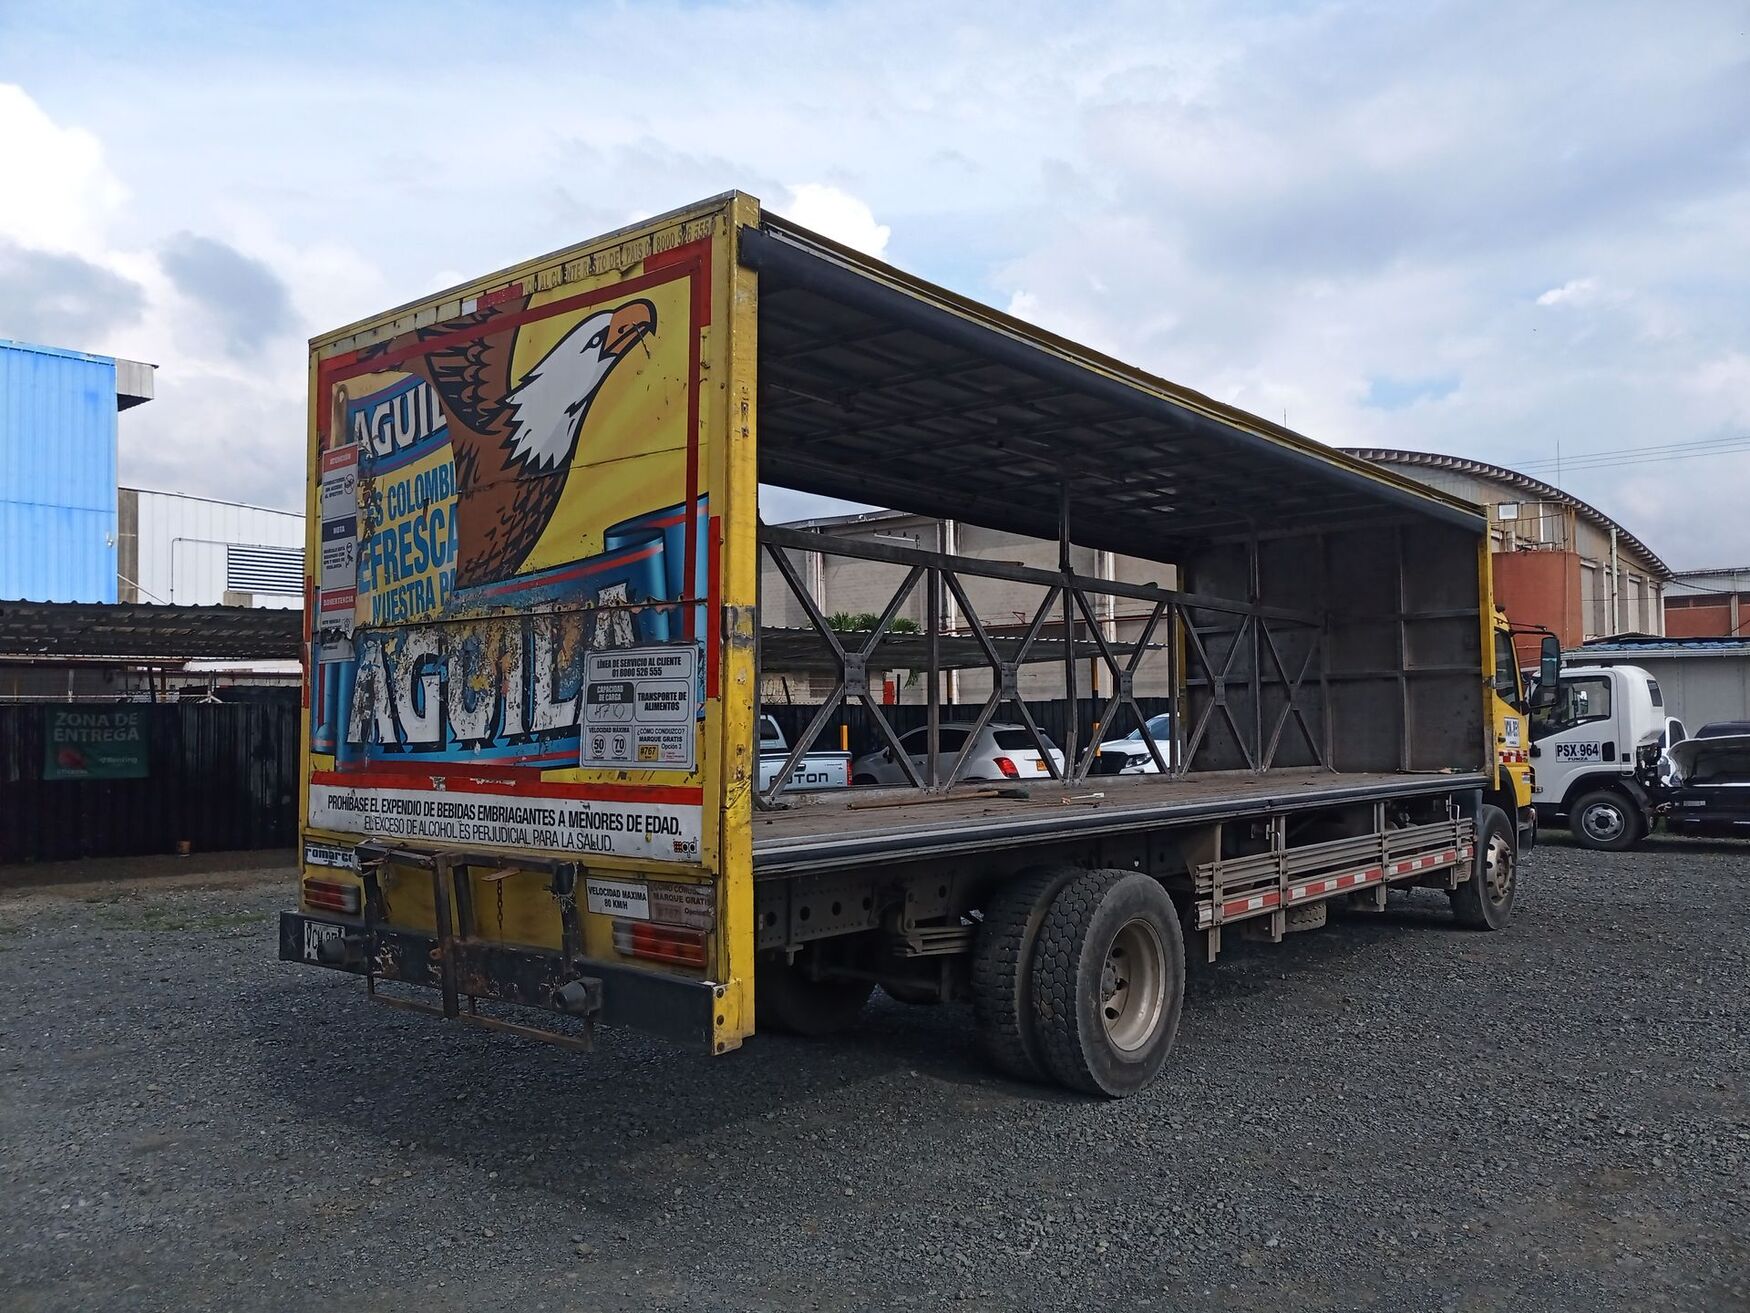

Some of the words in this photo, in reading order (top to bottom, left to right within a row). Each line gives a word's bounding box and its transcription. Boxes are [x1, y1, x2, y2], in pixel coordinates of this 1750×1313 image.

[656, 232, 676, 253] 8000
[372, 575, 436, 626] NUESTRA
[612, 659, 620, 668] DE
[620, 658, 648, 668] SERVICIO
[648, 657, 656, 667] AL
[657, 656, 682, 666] CLIENTE
[612, 668, 619, 678] 01
[619, 668, 636, 678] 8000
[636, 667, 649, 677] 526
[649, 667, 662, 677] 555
[637, 691, 678, 702] TRANSPORTE
[679, 691, 687, 700] DE
[644, 701, 680, 711] ALIMENTOS
[55, 712, 110, 727] ZONA
[115, 712, 139, 726] DE
[54, 727, 139, 742] ENTREGA
[593, 738, 605, 750] 50
[614, 738, 625, 750] 70
[327, 793, 369, 812] PROHÍBASE
[370, 797, 380, 813] EL
[381, 798, 422, 817] EXPENDIO
[423, 801, 436, 818] DE
[437, 801, 476, 821] BEBIDAS
[477, 804, 556, 827] EMBRIAGANTES
[558, 810, 566, 828] A
[568, 810, 624, 832] MENORES
[626, 814, 643, 833] DE
[645, 815, 683, 836] EDAD.
[364, 816, 374, 831] EL
[374, 816, 405, 835] EXCESO
[406, 818, 418, 835] DE
[418, 820, 458, 839] ALCOHOL
[459, 823, 471, 840] ES
[472, 824, 532, 845] PERJUDICIAL
[533, 829, 560, 848] PARA
[561, 831, 575, 849] LA
[576, 833, 615, 852] SALUD.
[588, 886, 621, 898] VELOCIDAD
[621, 890, 647, 901] MAXIMA
